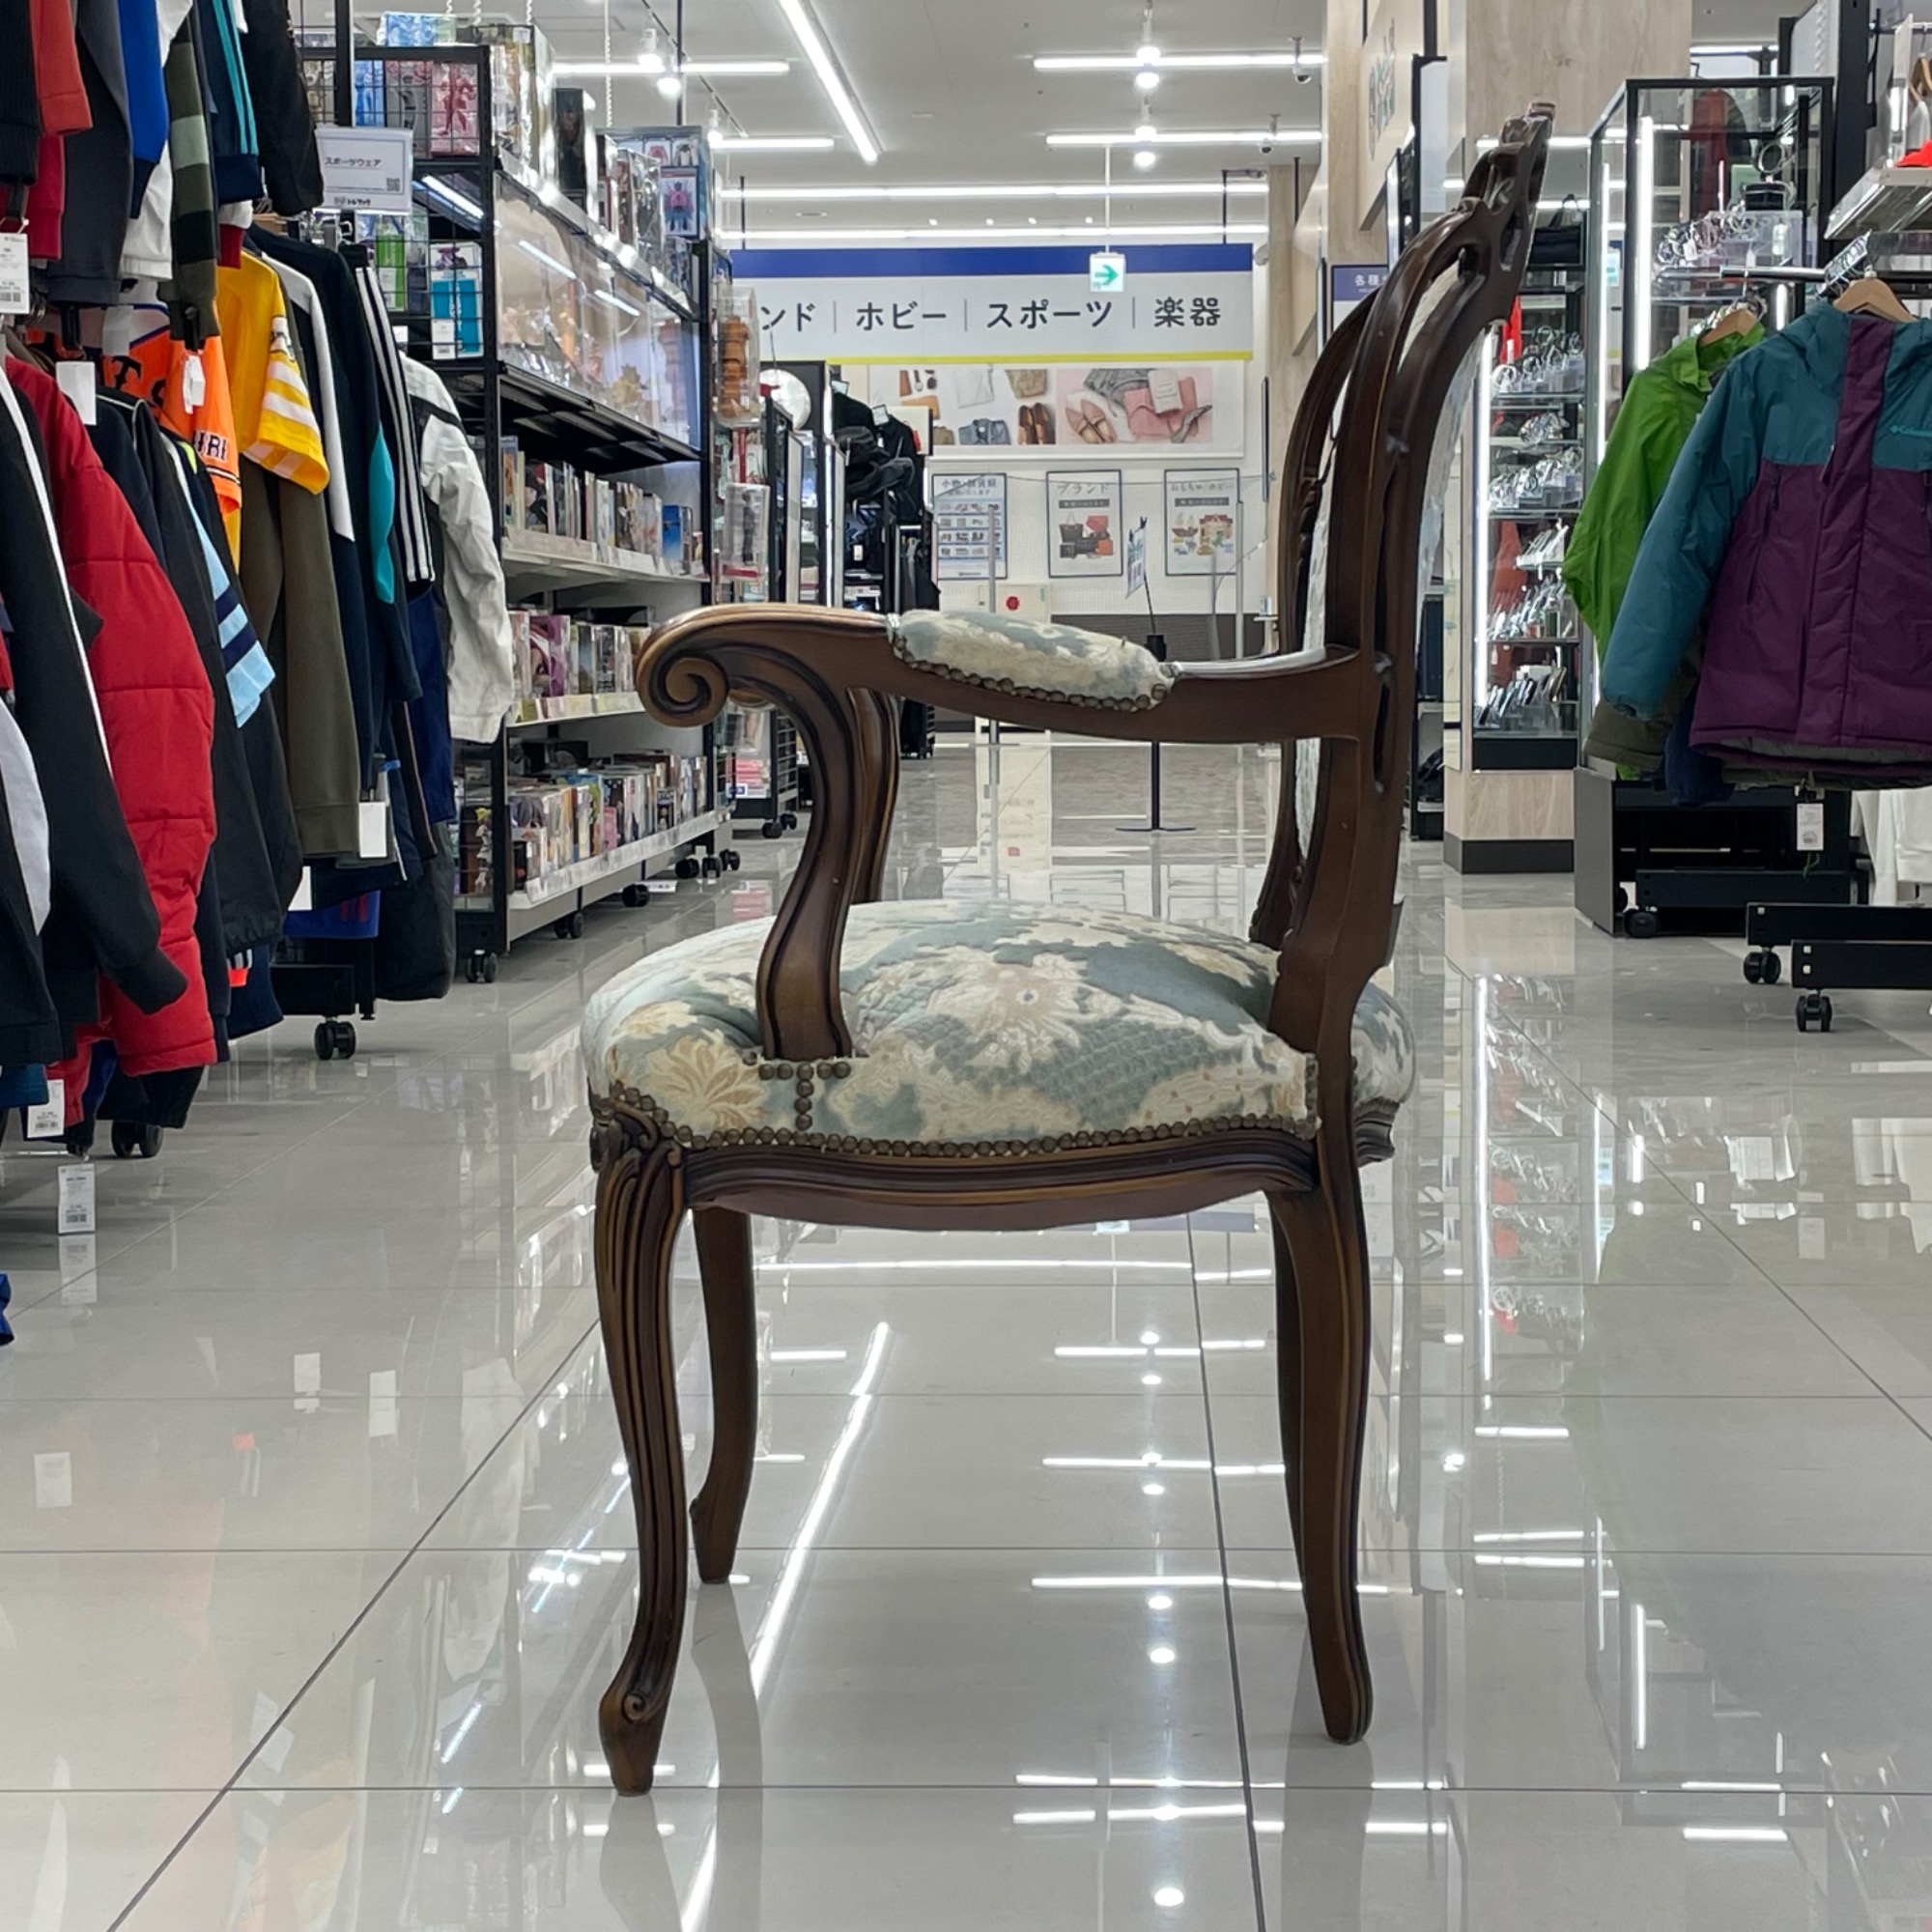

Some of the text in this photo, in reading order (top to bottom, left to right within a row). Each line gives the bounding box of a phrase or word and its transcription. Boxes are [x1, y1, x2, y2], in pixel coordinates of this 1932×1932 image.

[760, 296, 1222, 332] ンド ホビー スポーツ 楽器
